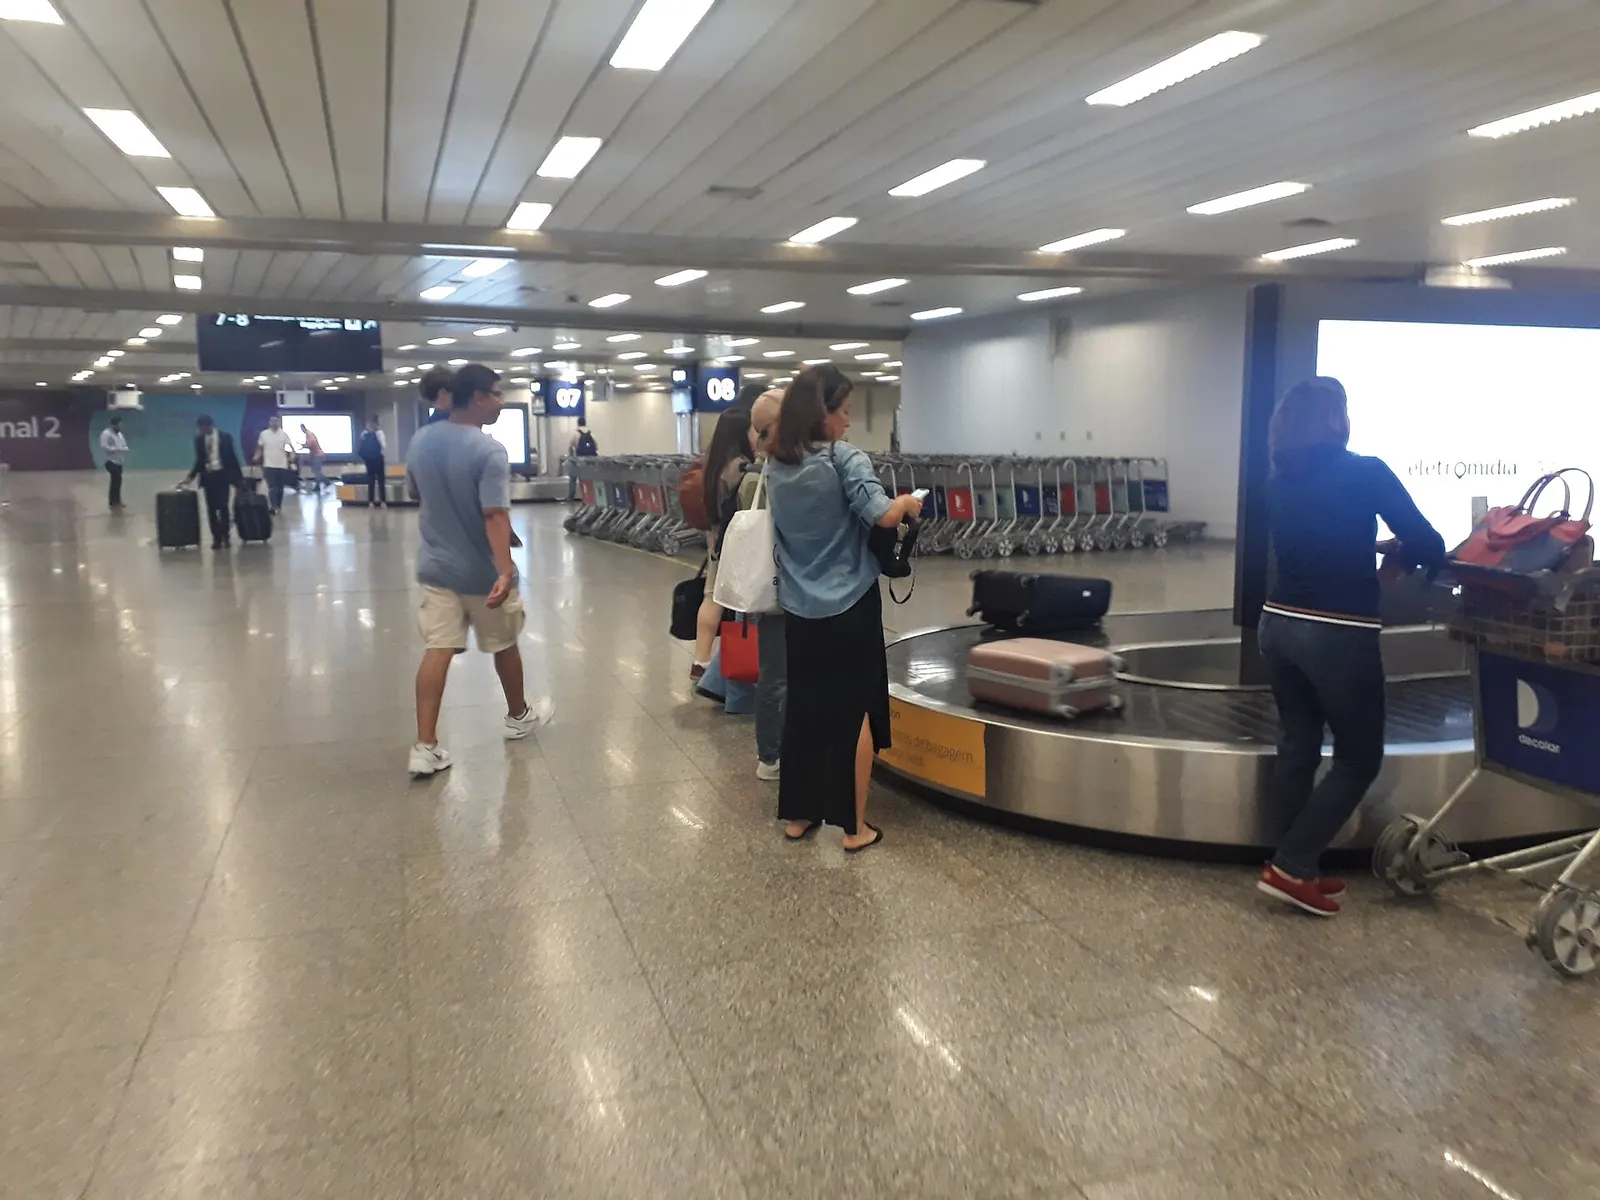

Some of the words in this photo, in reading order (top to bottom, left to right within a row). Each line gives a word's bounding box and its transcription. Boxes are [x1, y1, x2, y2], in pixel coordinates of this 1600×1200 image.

[556, 388, 582, 408] 07
[706, 377, 736, 401] 08
[42, 415, 63, 439] 2
[1517, 733, 1562, 755] decolar
